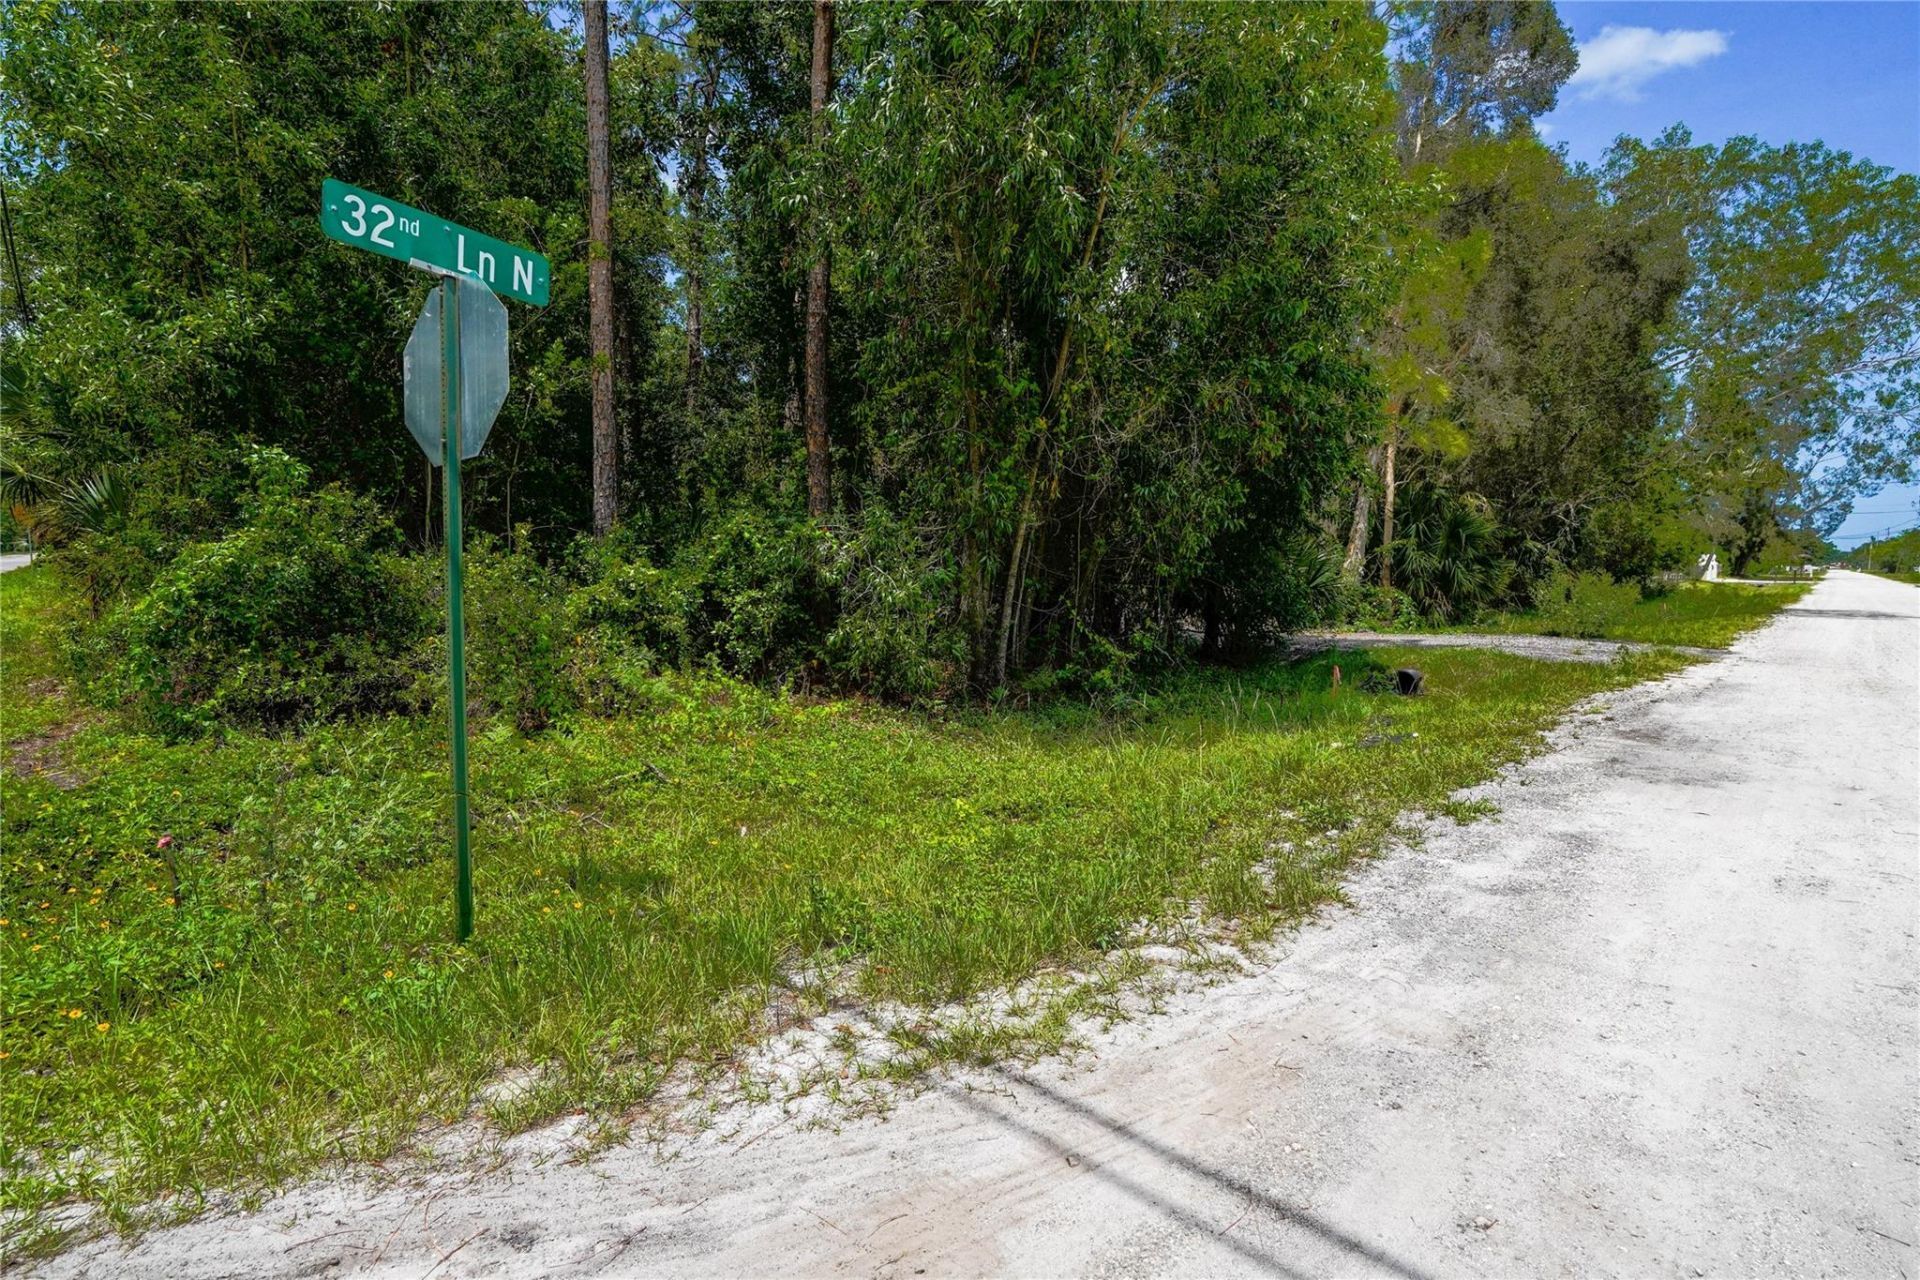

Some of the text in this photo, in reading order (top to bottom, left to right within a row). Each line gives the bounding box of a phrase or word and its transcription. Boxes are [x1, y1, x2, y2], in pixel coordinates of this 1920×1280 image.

[341, 194, 533, 296] 32nd Ln N
